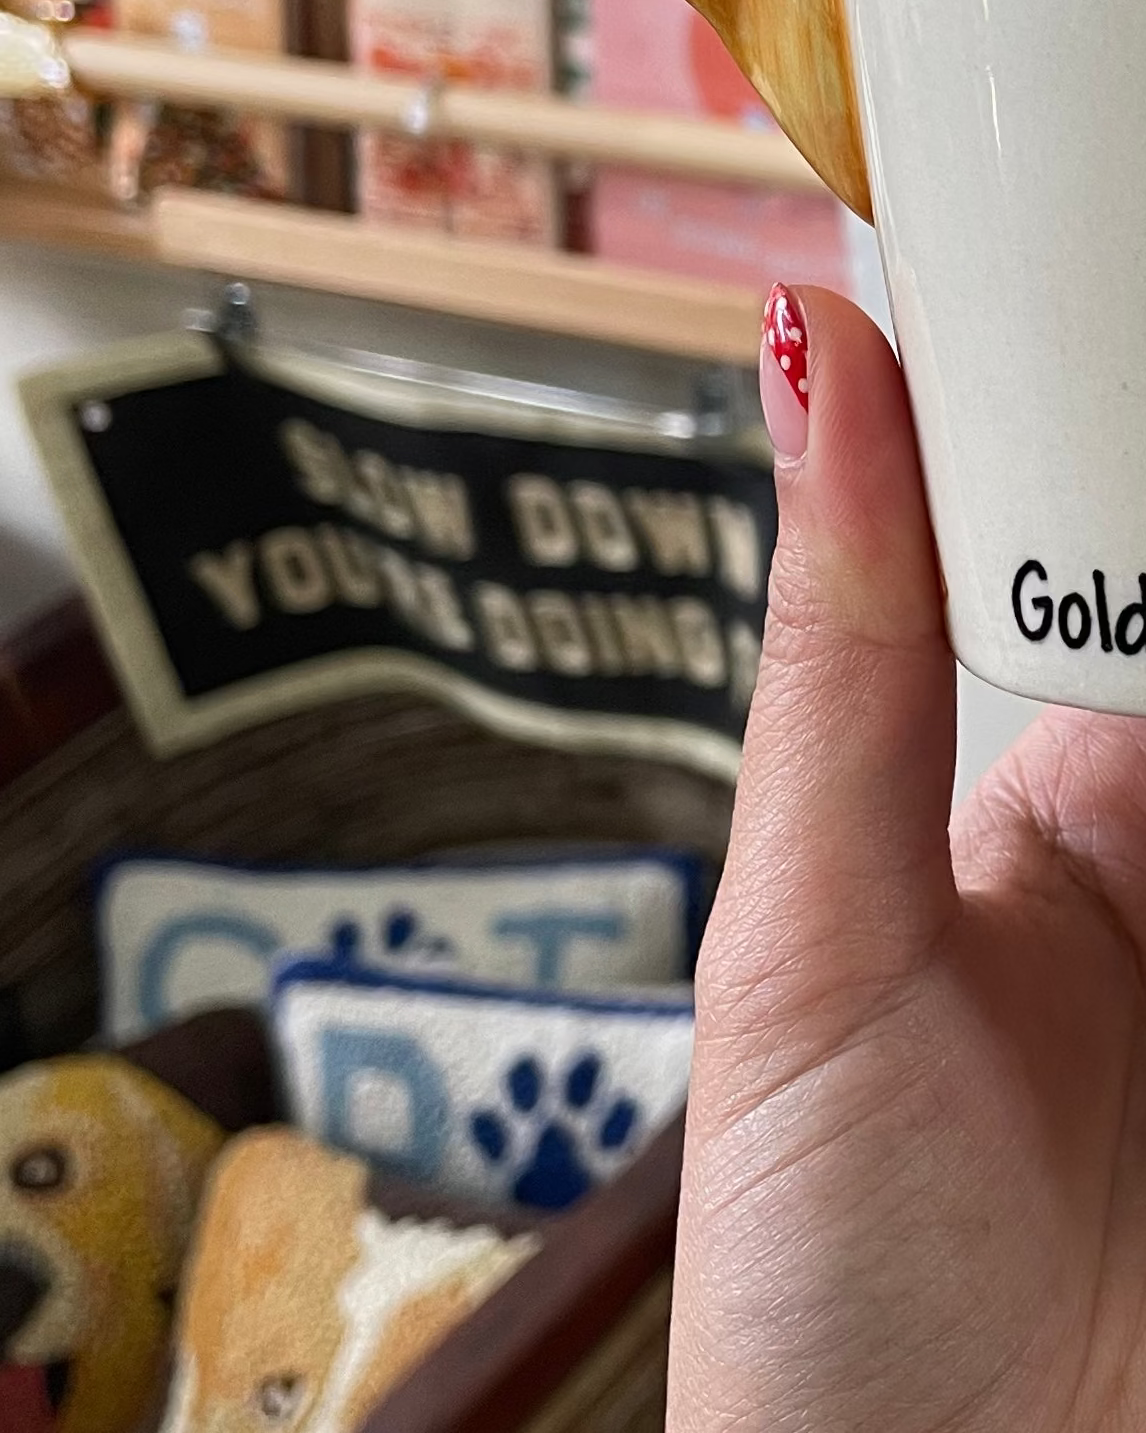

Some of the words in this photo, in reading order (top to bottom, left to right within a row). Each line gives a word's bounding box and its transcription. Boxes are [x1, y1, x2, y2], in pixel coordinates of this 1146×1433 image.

[278, 418, 475, 561] SLOW
[507, 472, 761, 602] DOWN
[475, 580, 727, 689] DOING
